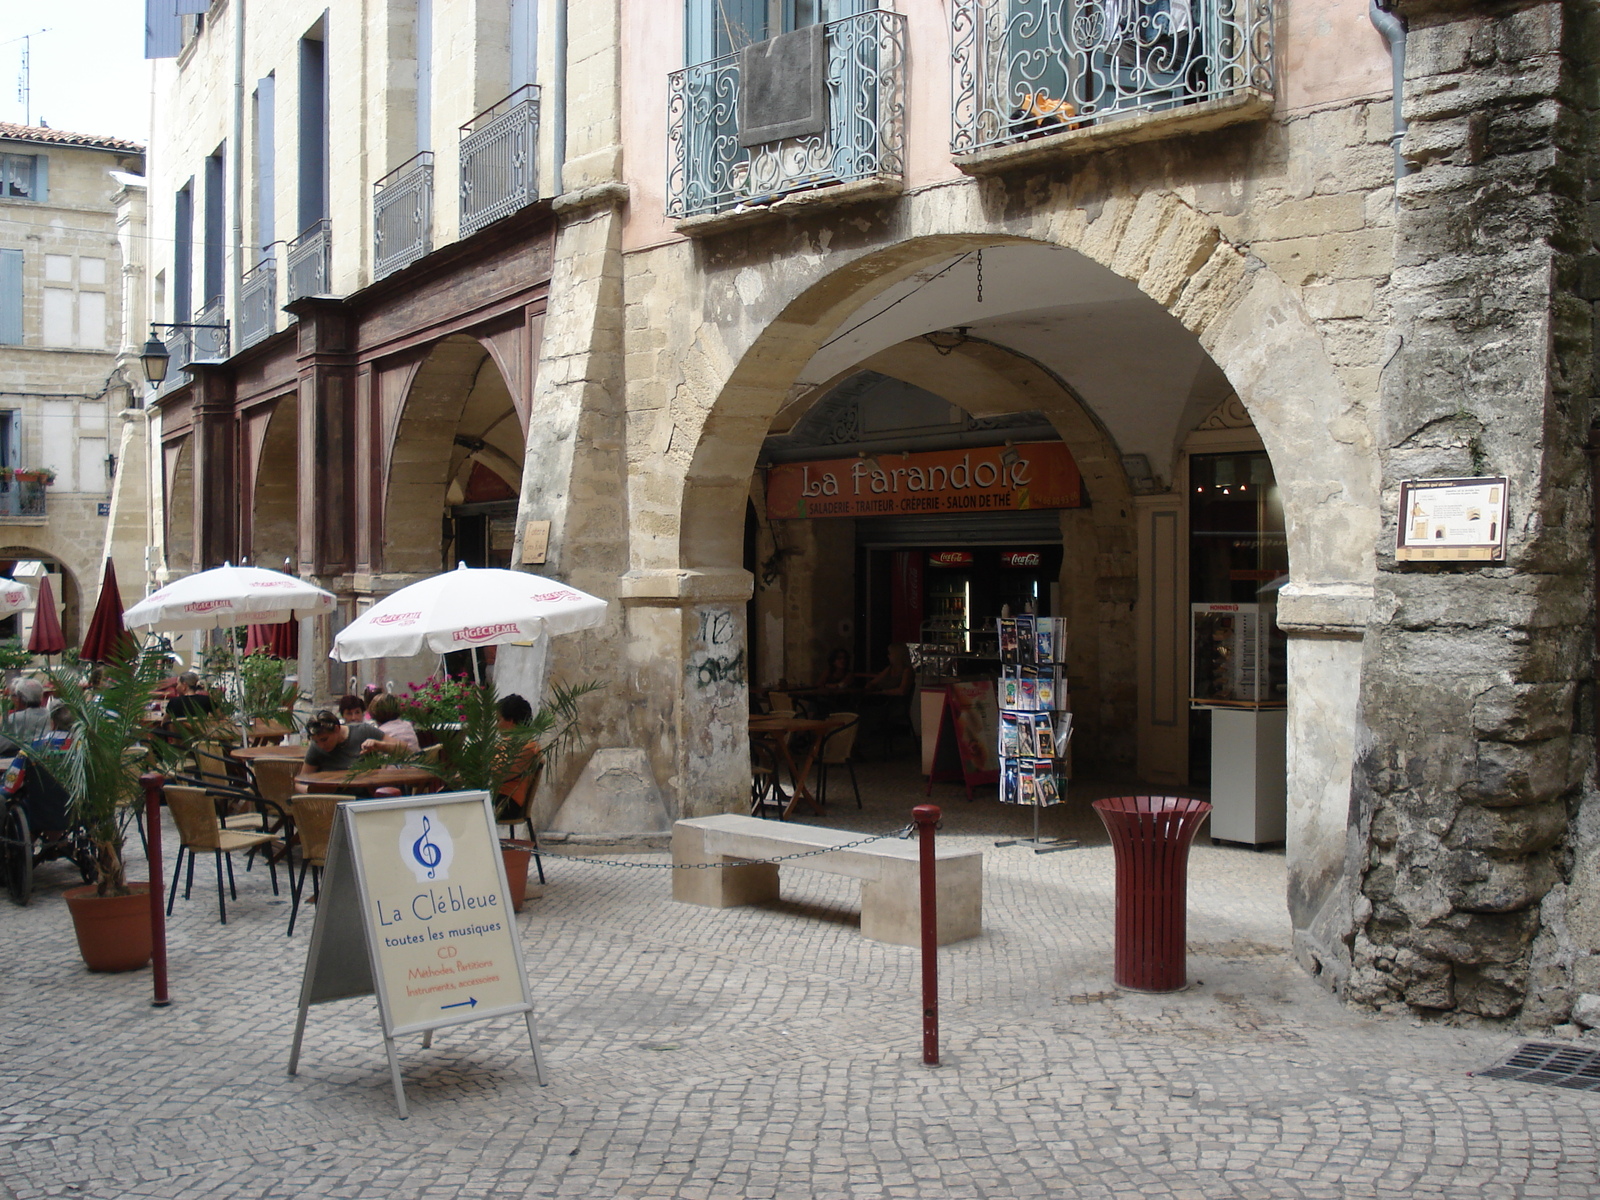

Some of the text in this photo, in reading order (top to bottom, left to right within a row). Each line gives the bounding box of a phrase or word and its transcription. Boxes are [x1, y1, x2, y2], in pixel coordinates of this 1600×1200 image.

[801, 453, 1033, 498] La Farandole
[809, 501, 850, 515] SALADERIE
[855, 499, 894, 513] TRAITEUR
[900, 495, 940, 511] CRÊPERIE
[946, 494, 976, 509] SALON
[979, 494, 991, 507] DE
[993, 490, 1011, 506] THÉ
[1011, 553, 1040, 566] Coca-Cola
[377, 900, 403, 926] La
[385, 922, 501, 947] toutes les musiques
[437, 945, 458, 959] CD
[456, 960, 493, 972] Partitions
[406, 974, 500, 997] Instruments, accessoires
